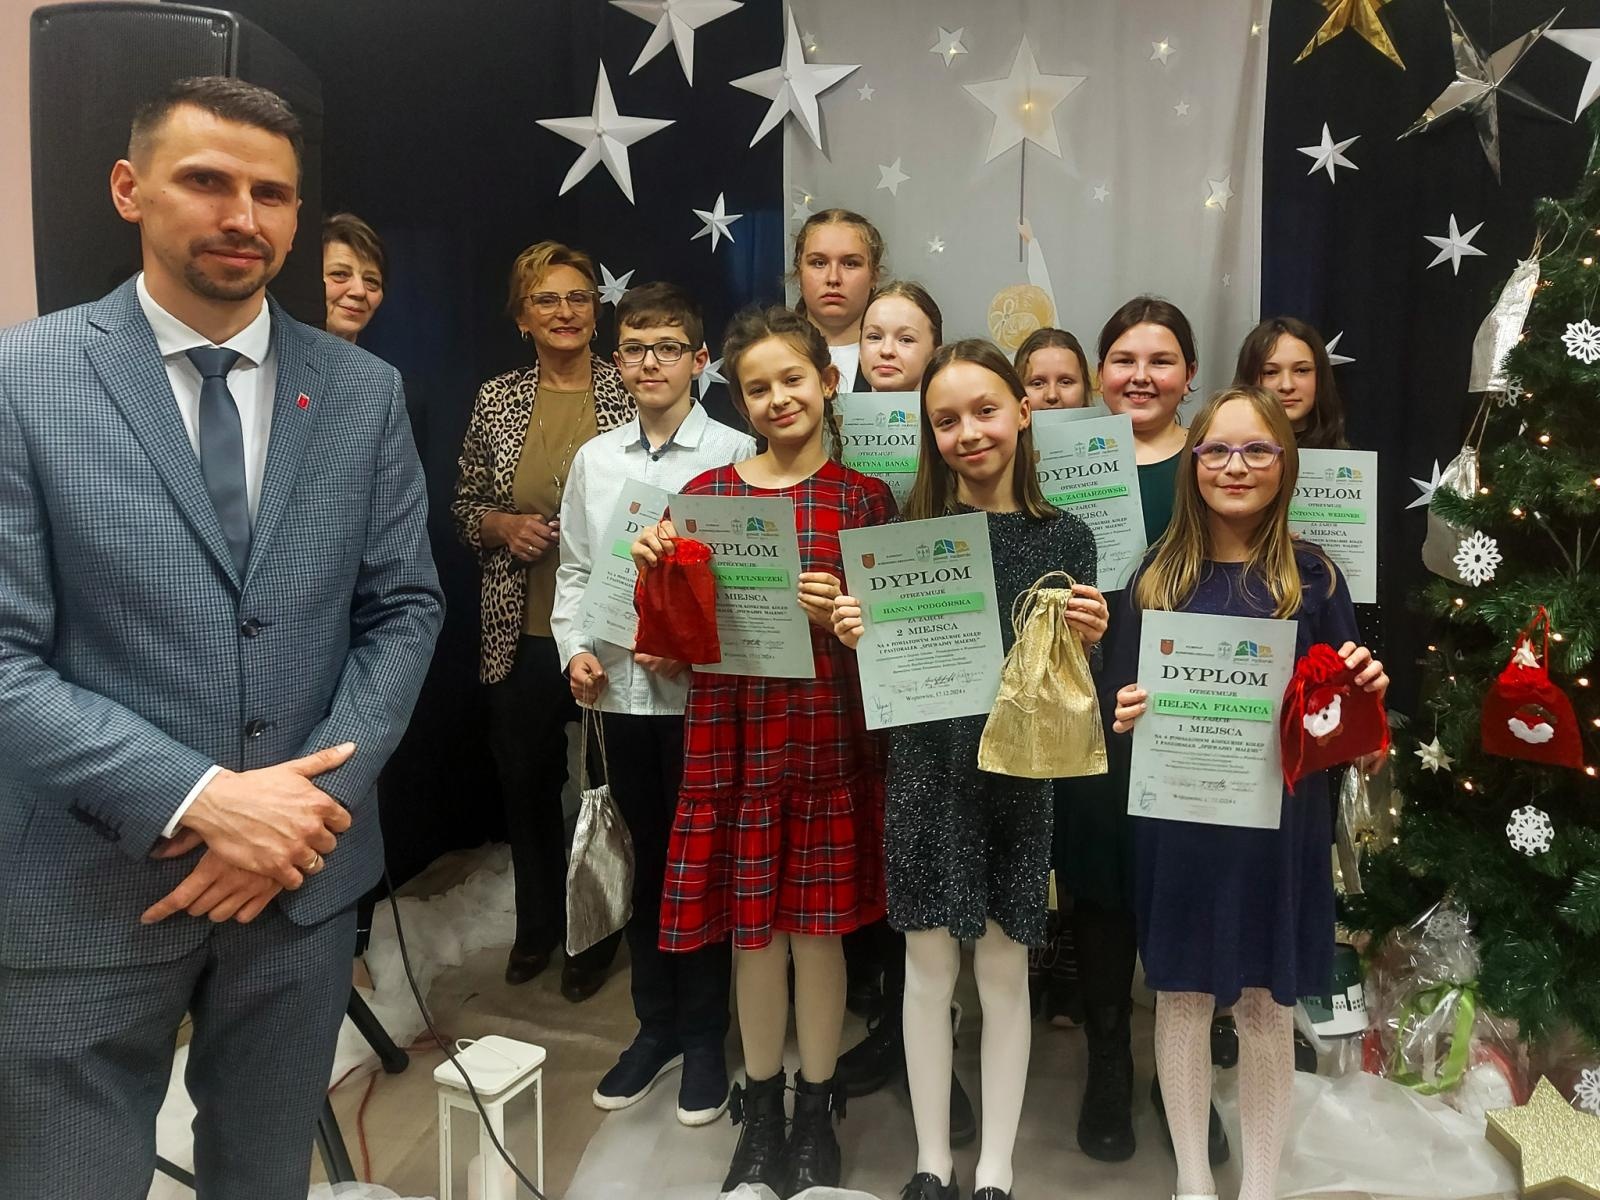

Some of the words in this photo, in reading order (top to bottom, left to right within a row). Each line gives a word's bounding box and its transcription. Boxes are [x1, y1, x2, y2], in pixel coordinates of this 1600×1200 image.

[1036, 460, 1120, 483] DYPLOM
[1293, 487, 1361, 500] DYPLOM
[1078, 510, 1108, 520] EJSCA
[707, 543, 779, 557] YPLOM
[870, 566, 972, 591] DYPLOM
[725, 593, 768, 602] MIEJSCA
[900, 589, 945, 599] OTRZYMUJE
[883, 606, 913, 614] HANNA
[917, 599, 972, 611] PODGÓRSKA
[896, 629, 903, 637] 2
[908, 623, 959, 635] MIEJSCA
[1160, 665, 1269, 687] DYPLOM
[1190, 688, 1238, 697] OTRZYMUJE
[1158, 699, 1207, 710] HELENA
[1214, 703, 1269, 715] FRANICA
[1178, 724, 1183, 732] 1
[1189, 725, 1243, 737] MIEJSCA
